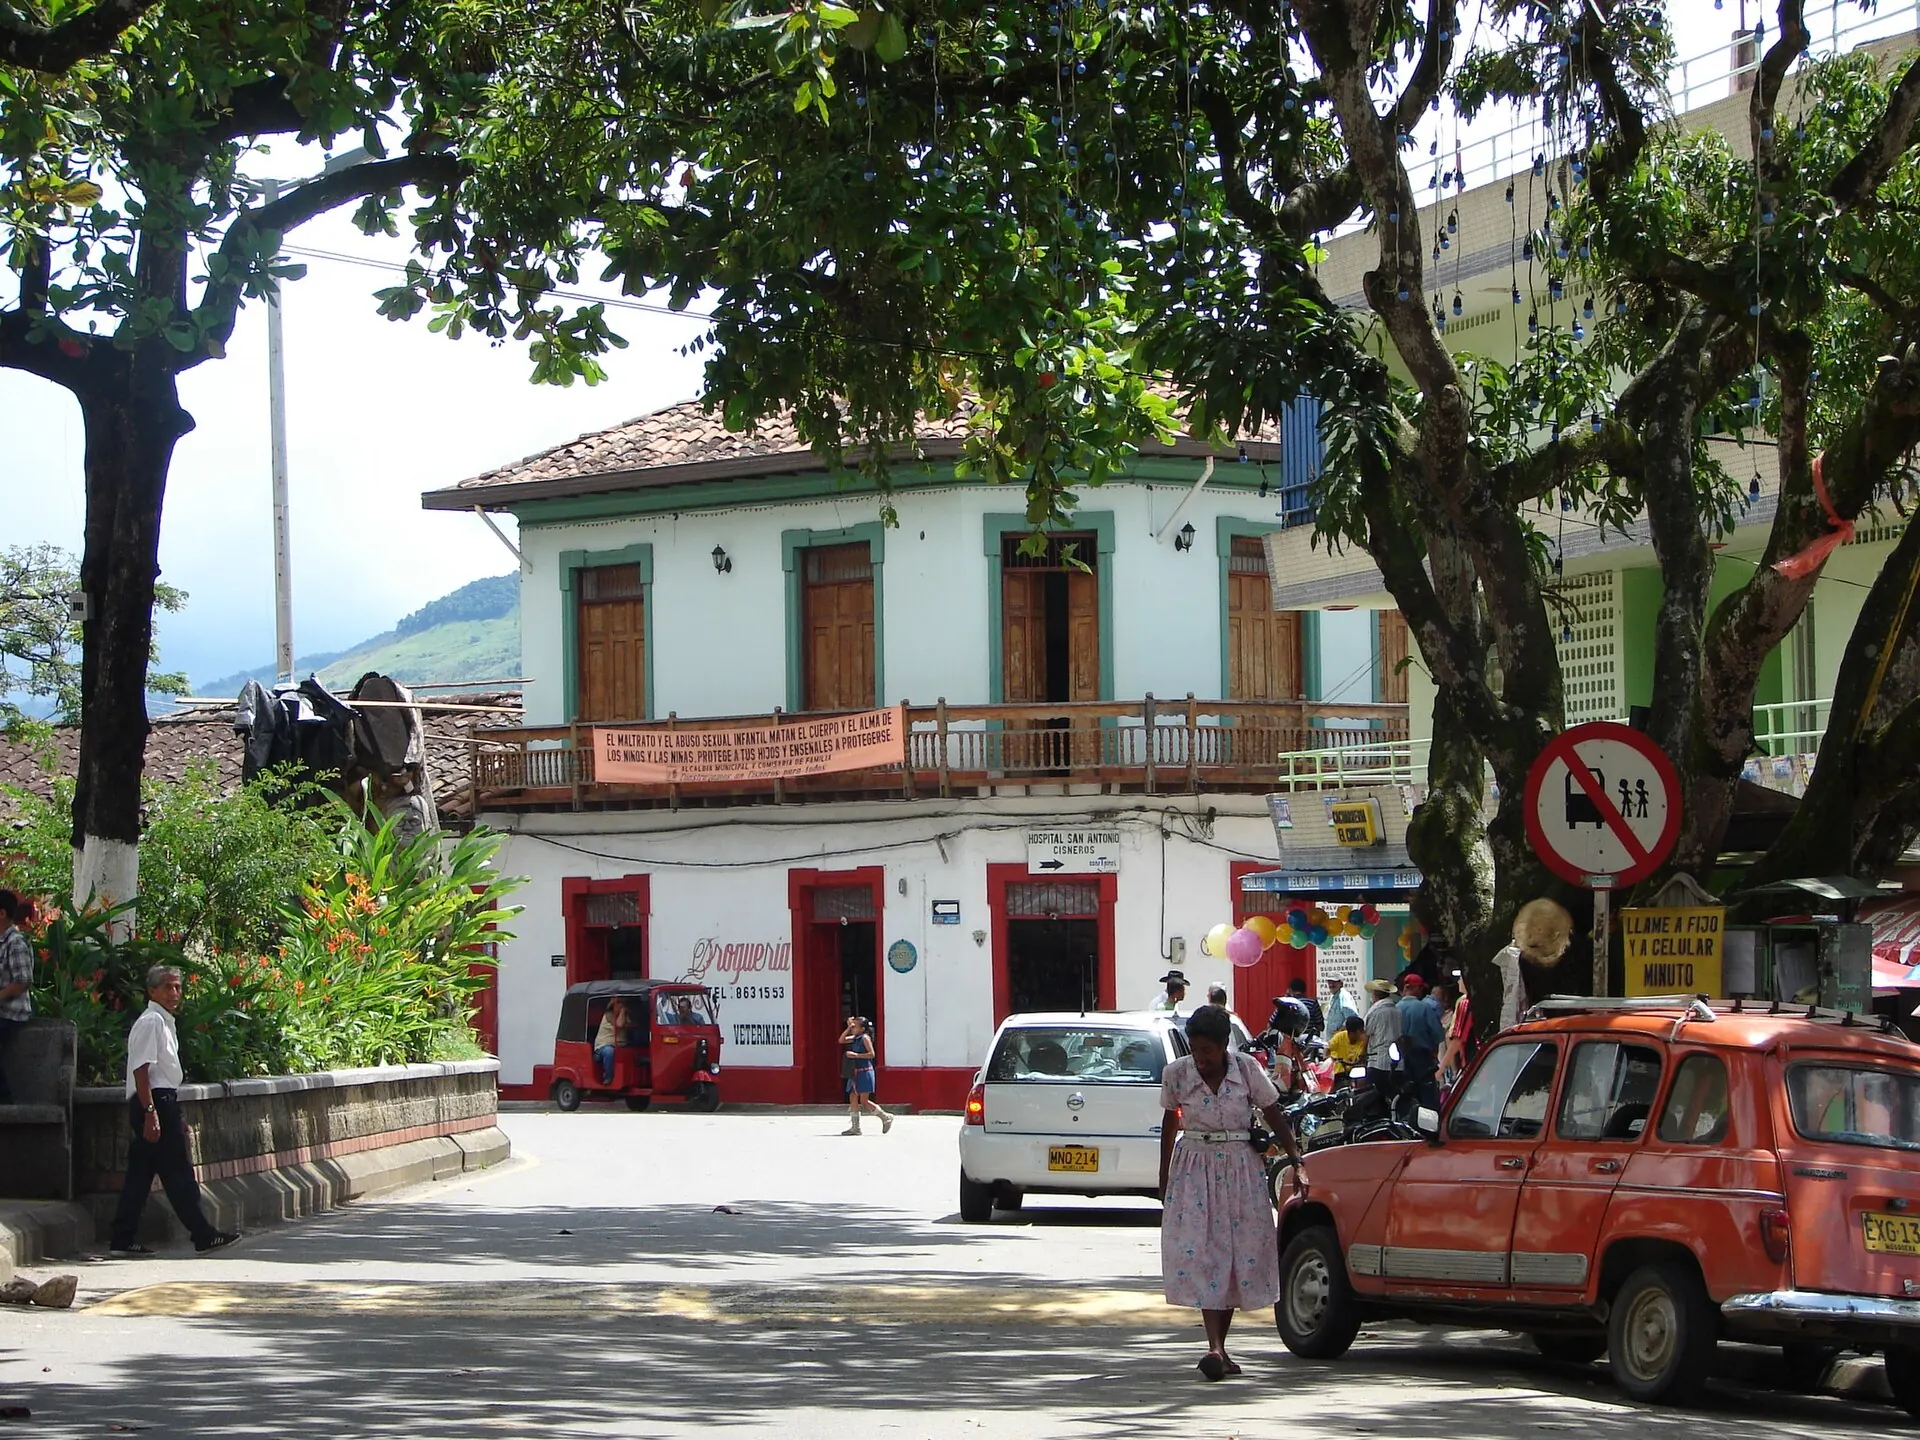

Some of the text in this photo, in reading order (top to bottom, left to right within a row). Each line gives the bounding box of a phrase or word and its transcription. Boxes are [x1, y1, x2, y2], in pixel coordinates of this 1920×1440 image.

[607, 712, 892, 748] EL MALTRATO Y EL ABUSO SEXUAL INFANTIL MATAN EL CUERPO Y EL ALMA DE
[607, 750, 621, 762] LOS
[647, 751, 652, 763] Y
[654, 751, 668, 763] LAS
[698, 749, 732, 763] PROTEGE
[734, 749, 739, 761] A
[741, 747, 755, 761] TUS
[758, 745, 780, 760] HIJOS
[782, 745, 788, 758] Y
[835, 738, 841, 751] A
[715, 763, 748, 771] MUNICIPAL
[1028, 833, 1119, 844] HOSPITAL SAN ANTONIO
[1053, 845, 1095, 854] CISNEROS
[1626, 915, 1718, 934] LLAME A FIJO
[1629, 938, 1713, 957] Y A CELULAR
[1644, 963, 1693, 987] MINUTO
[733, 1024, 791, 1045] VETERINARIA
